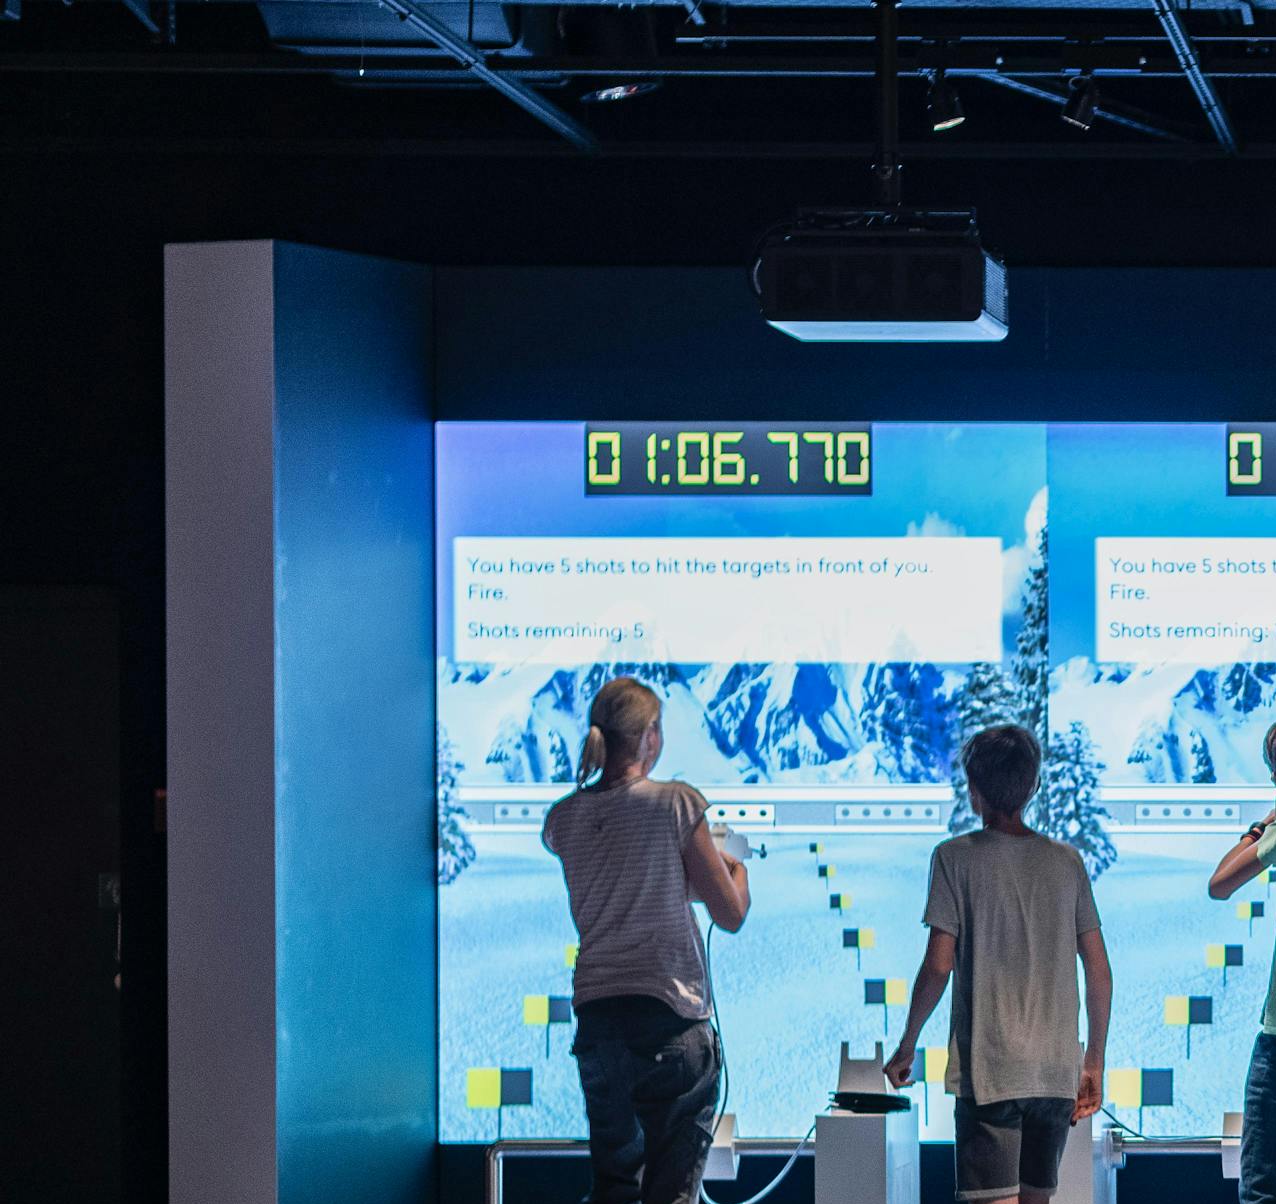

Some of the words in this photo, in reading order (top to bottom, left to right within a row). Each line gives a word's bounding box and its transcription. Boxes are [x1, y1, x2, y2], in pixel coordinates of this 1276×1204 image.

[588, 432, 870, 485] 01:06.770
[468, 557, 503, 574] You
[510, 558, 555, 574] have
[561, 558, 571, 574] 5
[576, 558, 626, 575] shots
[631, 559, 650, 574] to
[656, 558, 680, 574] hit
[686, 558, 717, 574] the
[722, 559, 791, 579] targets
[797, 559, 813, 574] in
[819, 557, 864, 574] front
[869, 557, 889, 574] of
[894, 563, 933, 578] you.
[1110, 557, 1146, 574] You
[1152, 558, 1197, 574] have
[1202, 558, 1213, 574] 5
[1217, 558, 1267, 575] shots
[467, 583, 508, 600] Fire.
[1110, 583, 1150, 600] Fire.
[467, 621, 519, 639] Shots
[524, 621, 628, 643] remaining:
[633, 622, 644, 639] 5
[1109, 621, 1161, 639] Shots
[1166, 622, 1270, 643] remaining:
